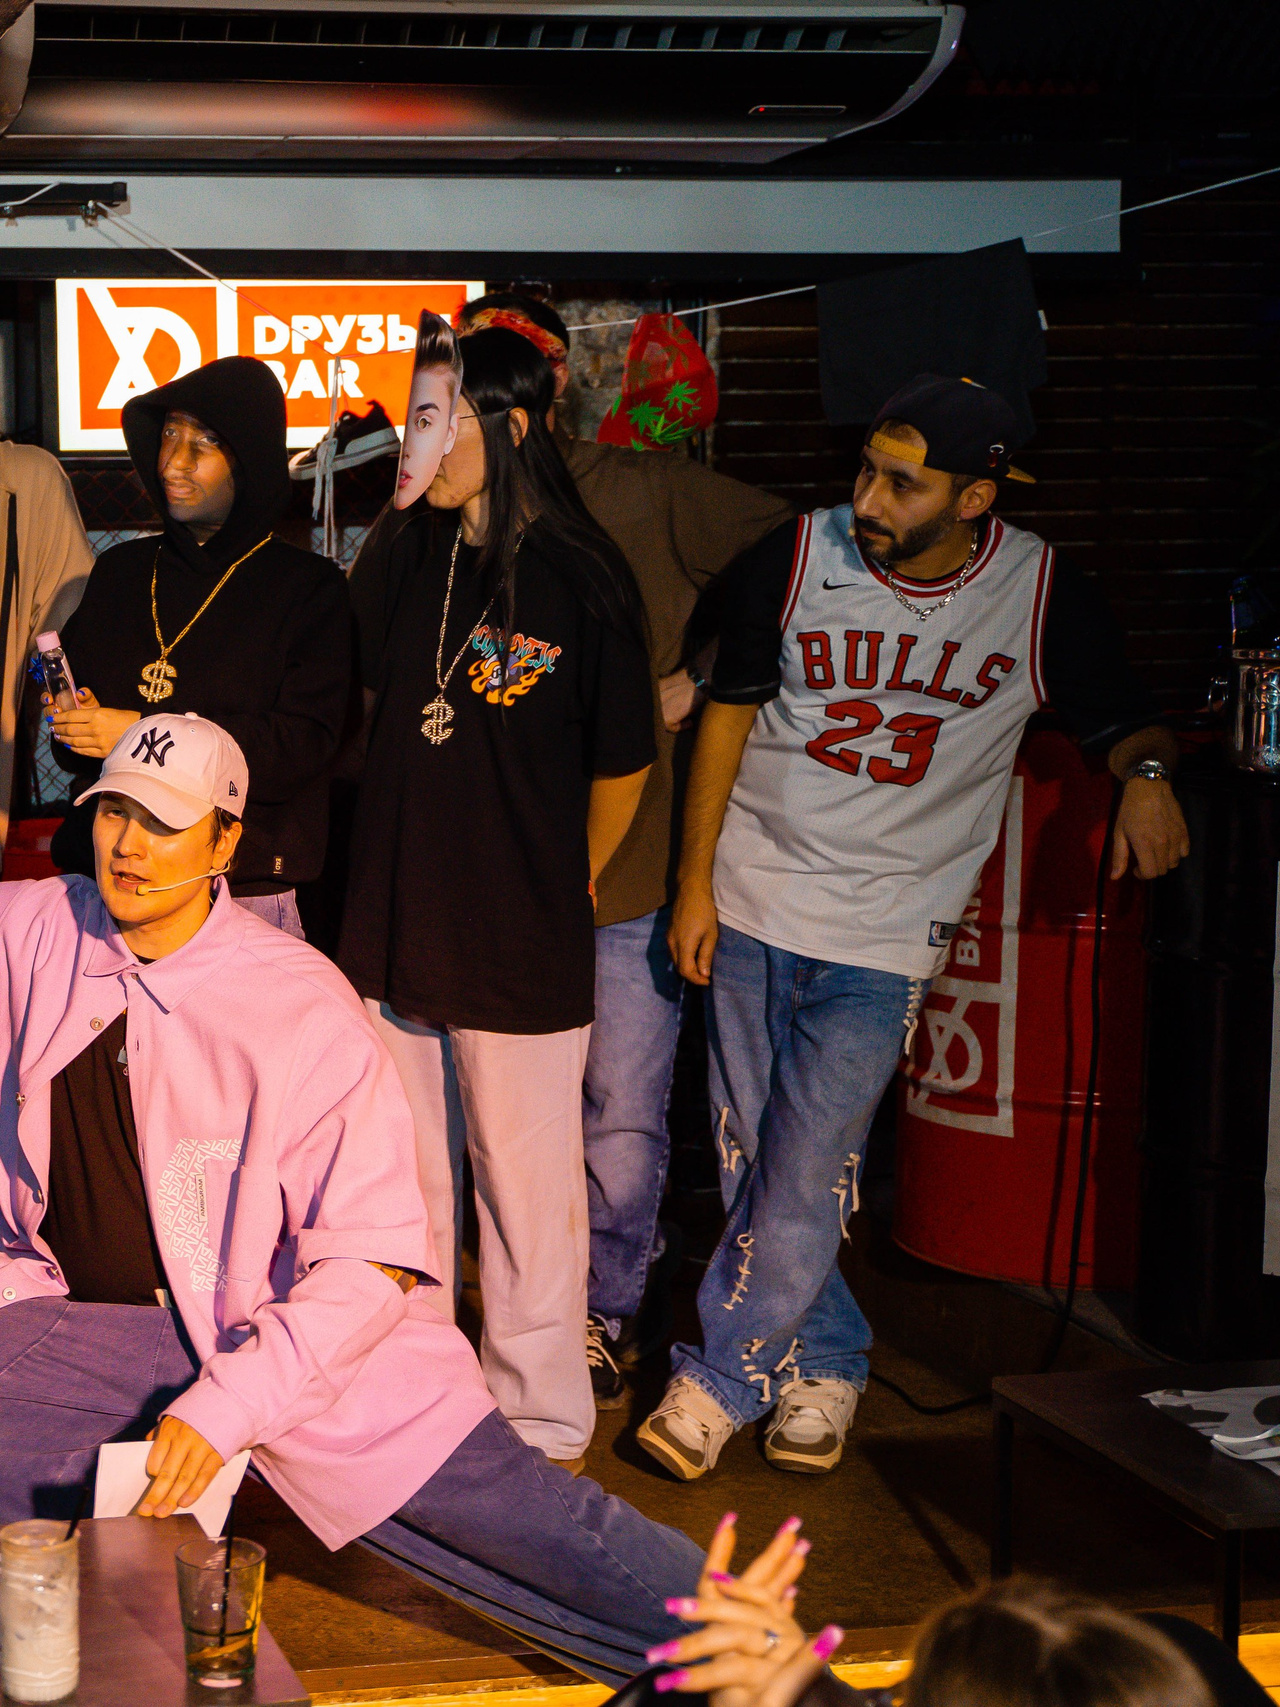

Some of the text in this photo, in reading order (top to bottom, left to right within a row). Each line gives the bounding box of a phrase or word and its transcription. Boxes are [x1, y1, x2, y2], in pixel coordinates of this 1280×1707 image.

[253, 314, 450, 354] DРУЗЬ
[796, 630, 1017, 709] BULLS
[805, 699, 945, 788] 23
[955, 882, 981, 967] BA
[197, 1178, 206, 1217] AMBIGRAM
